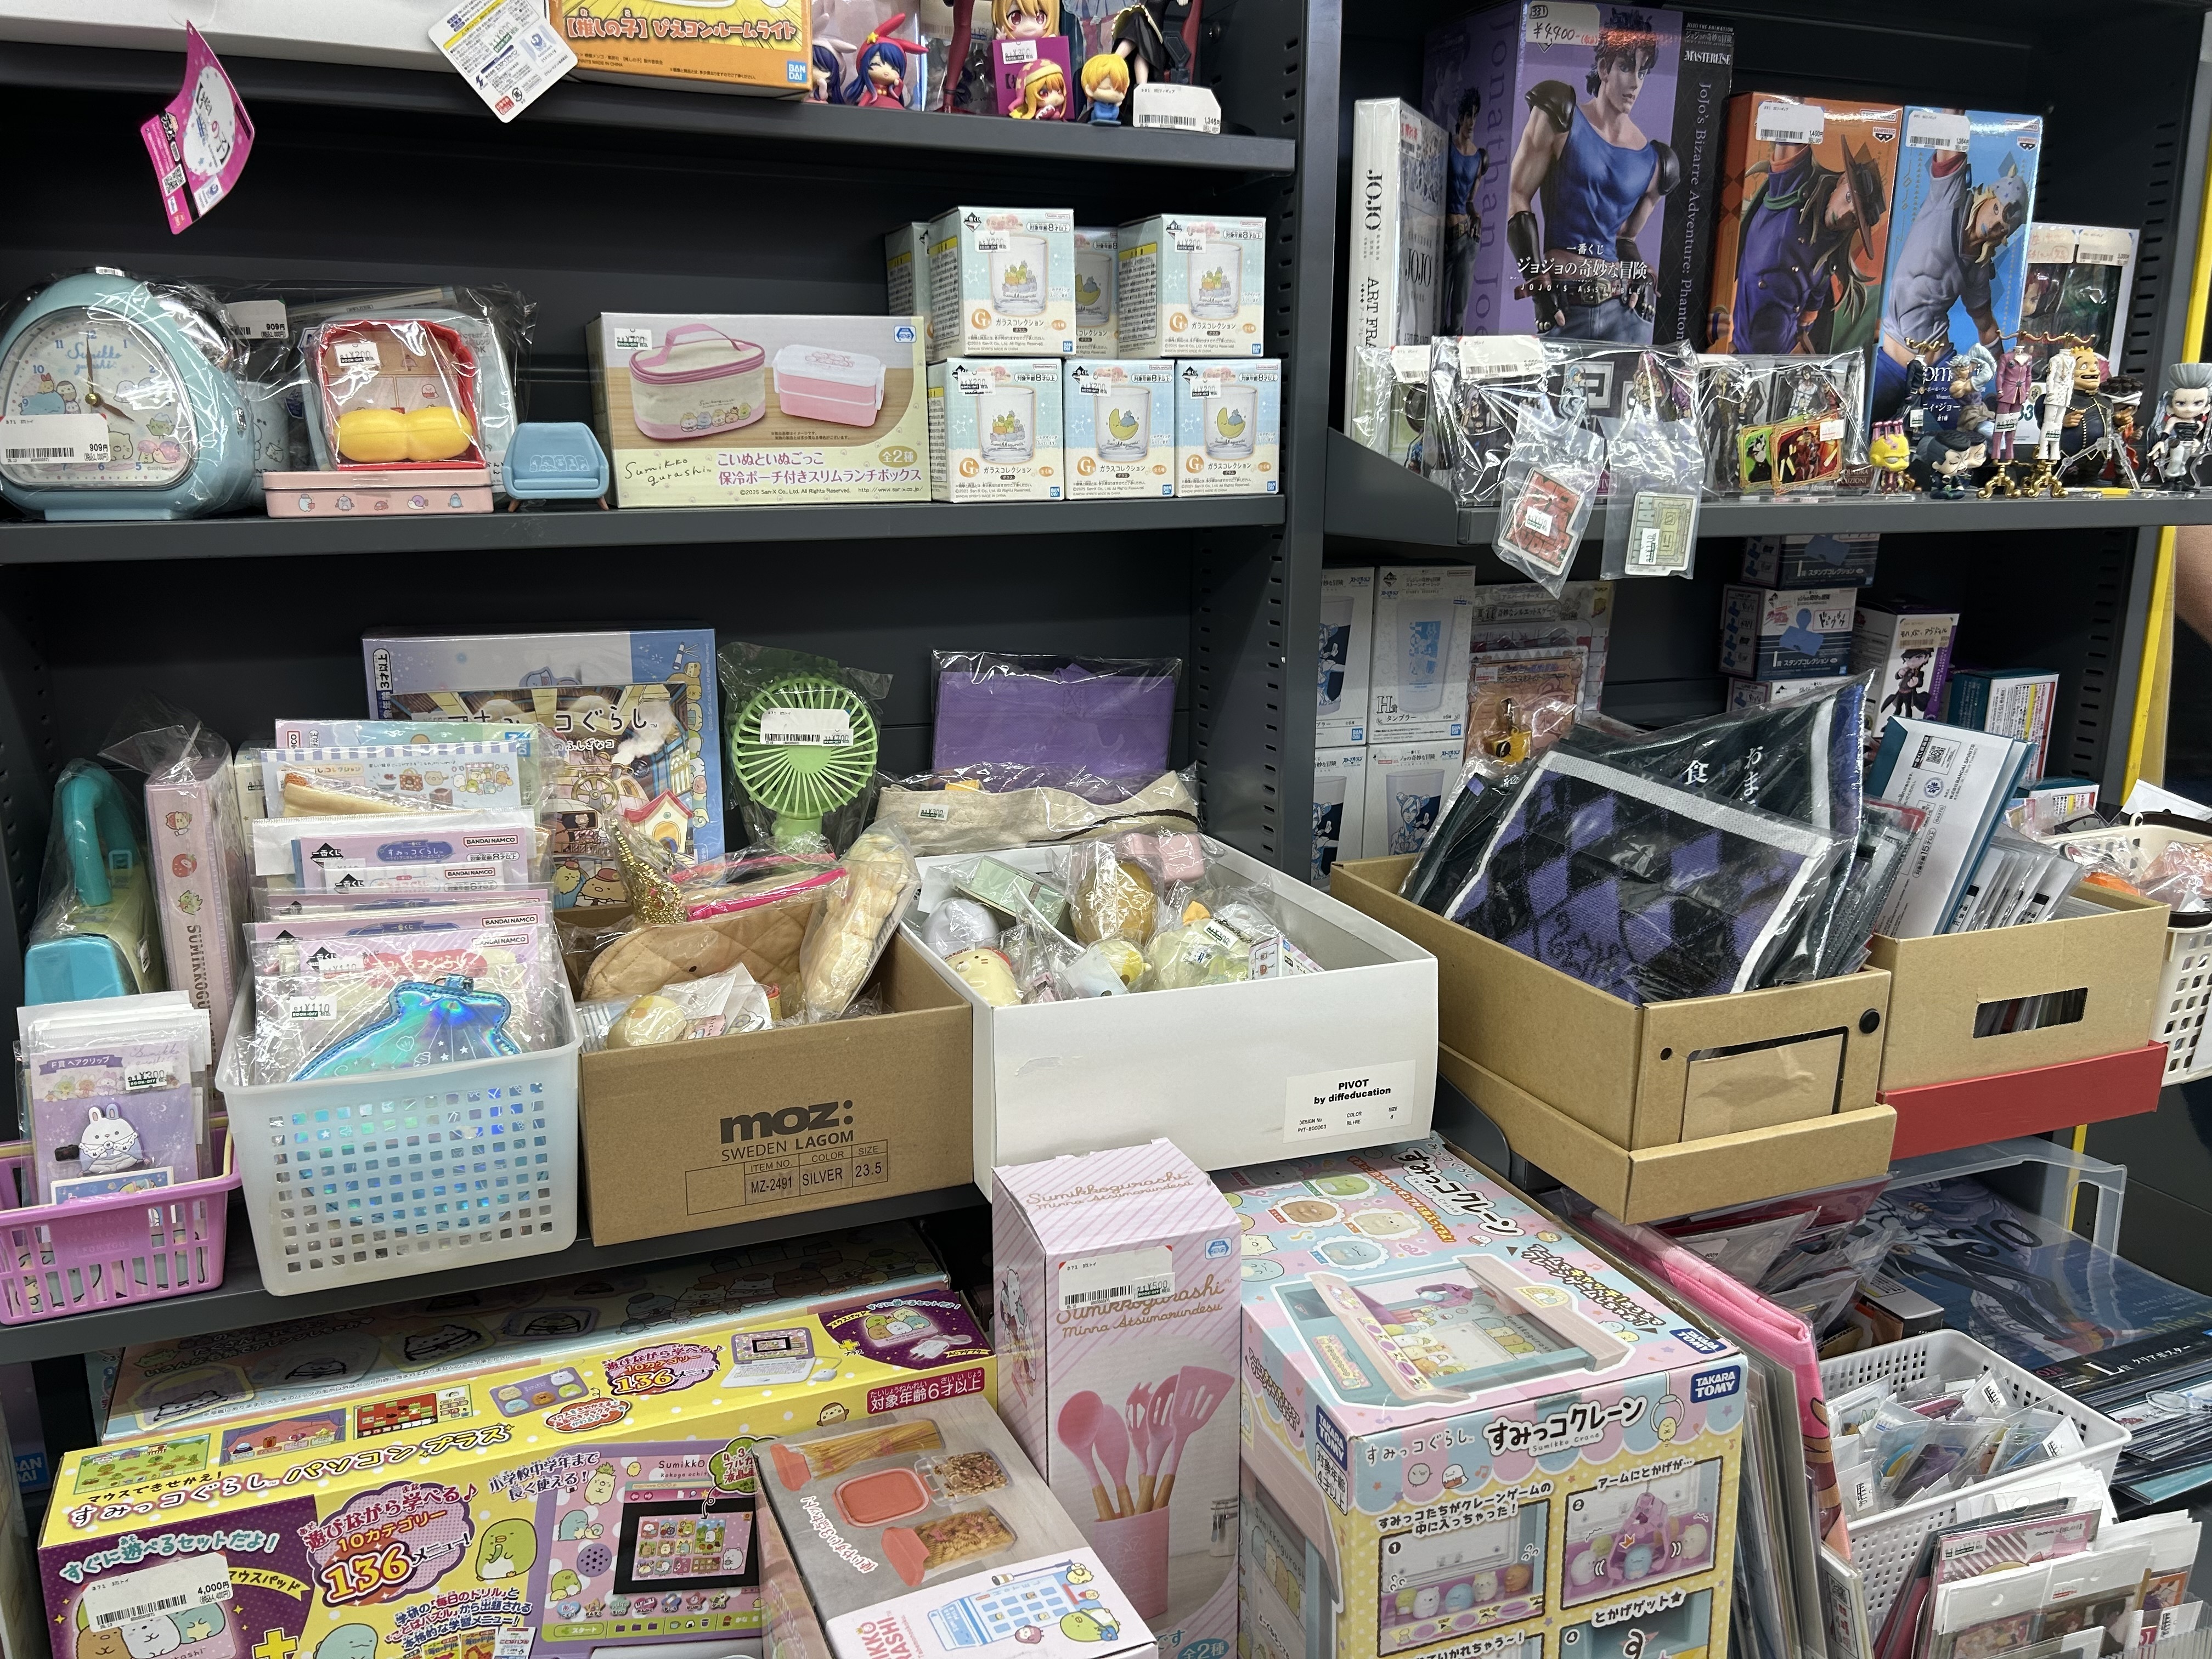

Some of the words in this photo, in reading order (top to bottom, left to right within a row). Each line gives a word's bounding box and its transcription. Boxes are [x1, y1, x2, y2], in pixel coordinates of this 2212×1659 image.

[566, 16, 649, 38] 【推しの子】
[788, 64, 805, 72] BAN
[788, 72, 803, 81] DAI
[1690, 129, 1708, 185] Bizarre
[1566, 242, 1605, 256] 一番くじ
[1516, 256, 1647, 280] ジョジョの奇妙な冒険
[55, 340, 64, 348] 11
[123, 339, 128, 348] 1
[33, 365, 45, 374] 10
[149, 365, 156, 373] 2
[22, 398, 29, 407] 9
[89, 444, 109, 452] 909円
[881, 449, 915, 464] 全2種
[98, 462, 105, 471] 6
[135, 462, 142, 471] 5
[718, 452, 824, 466] こいぬといぬごっこ
[624, 458, 688, 480] Sumikko
[718, 467, 922, 486] 保冷ポーチ付きスリムランチボックス
[1808, 567, 1855, 576] スタンプコレクション
[1783, 657, 1830, 667] スタンプコレクション
[1386, 714, 1417, 723] タンブラー
[1683, 759, 1709, 785] 食
[312, 849, 341, 857] 一番くじ
[387, 847, 439, 856] すみっコぐらし
[335, 880, 364, 888] 一番くじ
[511, 916, 535, 924] NAMCO
[500, 936, 527, 945] NAMCO
[50, 1060, 66, 1070] F賞
[67, 1056, 111, 1068] ヘアクリップ
[1338, 1079, 1369, 1091] PIVOT
[1313, 1096, 1325, 1105] by
[1328, 1087, 1392, 1103] diffeducation
[721, 1140, 788, 1163] SWEDEN
[794, 1130, 854, 1151] LAGOM
[857, 1145, 879, 1155] SIZE
[811, 1150, 845, 1163] COLOR
[750, 1162, 771, 1173] ITEM
[776, 1159, 793, 1171] NO.
[855, 1161, 883, 1178] 23.5
[751, 1175, 793, 1195] MZ-2491
[802, 1167, 843, 1188] SILVER
[1026, 1171, 1183, 1205] Sumikkogurashi
[1397, 1149, 1518, 1234] すみっコクレーン
[1062, 1323, 1110, 1339] Minna
[1113, 1302, 1223, 1330] Atsumarundesu
[1678, 1332, 1711, 1353] TOMY
[1688, 1330, 1720, 1351] TAKARA
[612, 1367, 675, 1395] 136
[1695, 1370, 1737, 1389] TAKARA
[871, 1378, 983, 1413] 対象年齢6才以上
[1695, 1381, 1736, 1398] TOMY
[1318, 1412, 1344, 1446] TAKARA
[1488, 1398, 1647, 1452] すみっコクレーン
[1318, 1423, 1345, 1462] TOMY
[1573, 1432, 1600, 1444] Crane
[1365, 1431, 1470, 1464] すみっコぐらし
[72, 1474, 266, 1527] すみっコぐらし
[285, 1446, 416, 1482] パソコン
[426, 1429, 510, 1455] プラス
[1317, 1449, 1346, 1493] 対象年齢
[88, 1471, 222, 1503] マウスできせかえ!
[1317, 1471, 1346, 1510] 4才以上
[1378, 1482, 1553, 1530] すみっコたちがクレーンゲームの
[1414, 1505, 1519, 1536] 中に入っちゃった!
[337, 1510, 448, 1554] 10カテゴリー
[60, 1531, 280, 1582] すぐに遊べるセットだよ!
[227, 1570, 301, 1592] マウスパッド
[324, 1545, 411, 1603] 136
[198, 1580, 230, 1595] 4,000円
